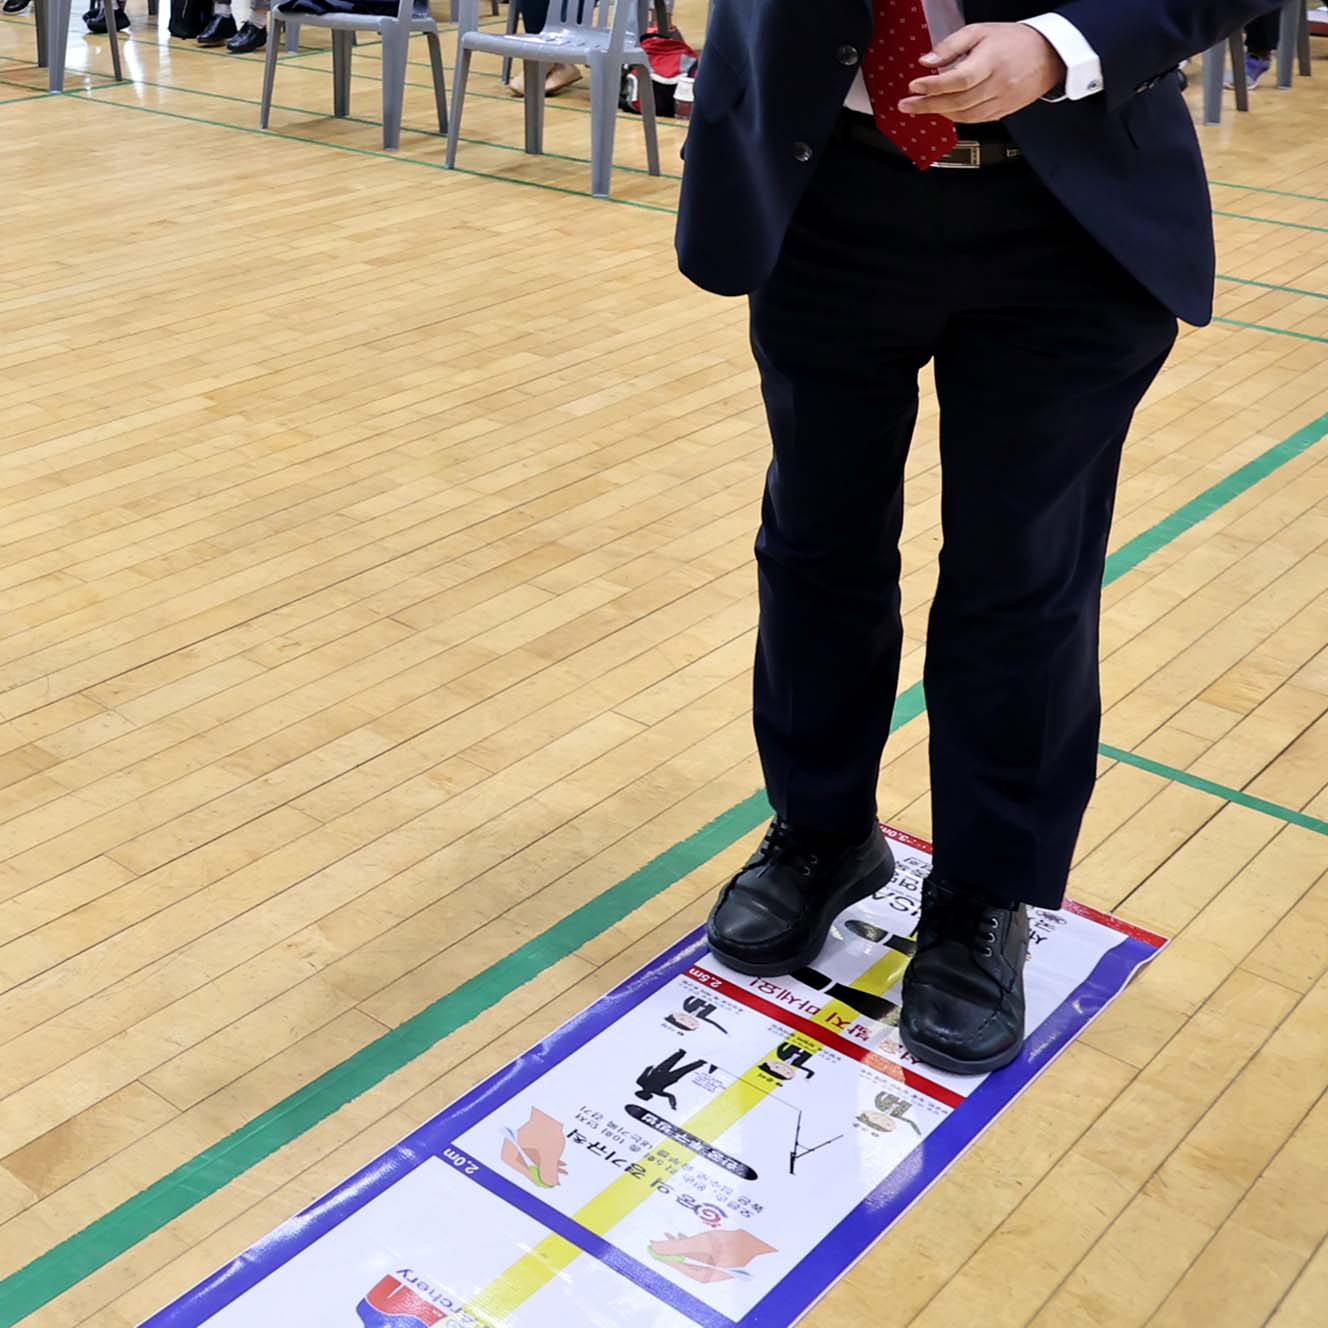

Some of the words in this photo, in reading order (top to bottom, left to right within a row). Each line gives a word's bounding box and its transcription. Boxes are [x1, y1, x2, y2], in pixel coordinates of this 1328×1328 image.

[689, 968, 723, 988] 2.5m
[748, 977, 821, 1016] 마세요!
[825, 1011, 872, 1042] 밟지
[443, 1148, 480, 1175] 2.0m
[567, 1129, 647, 1179] 경기규칙
